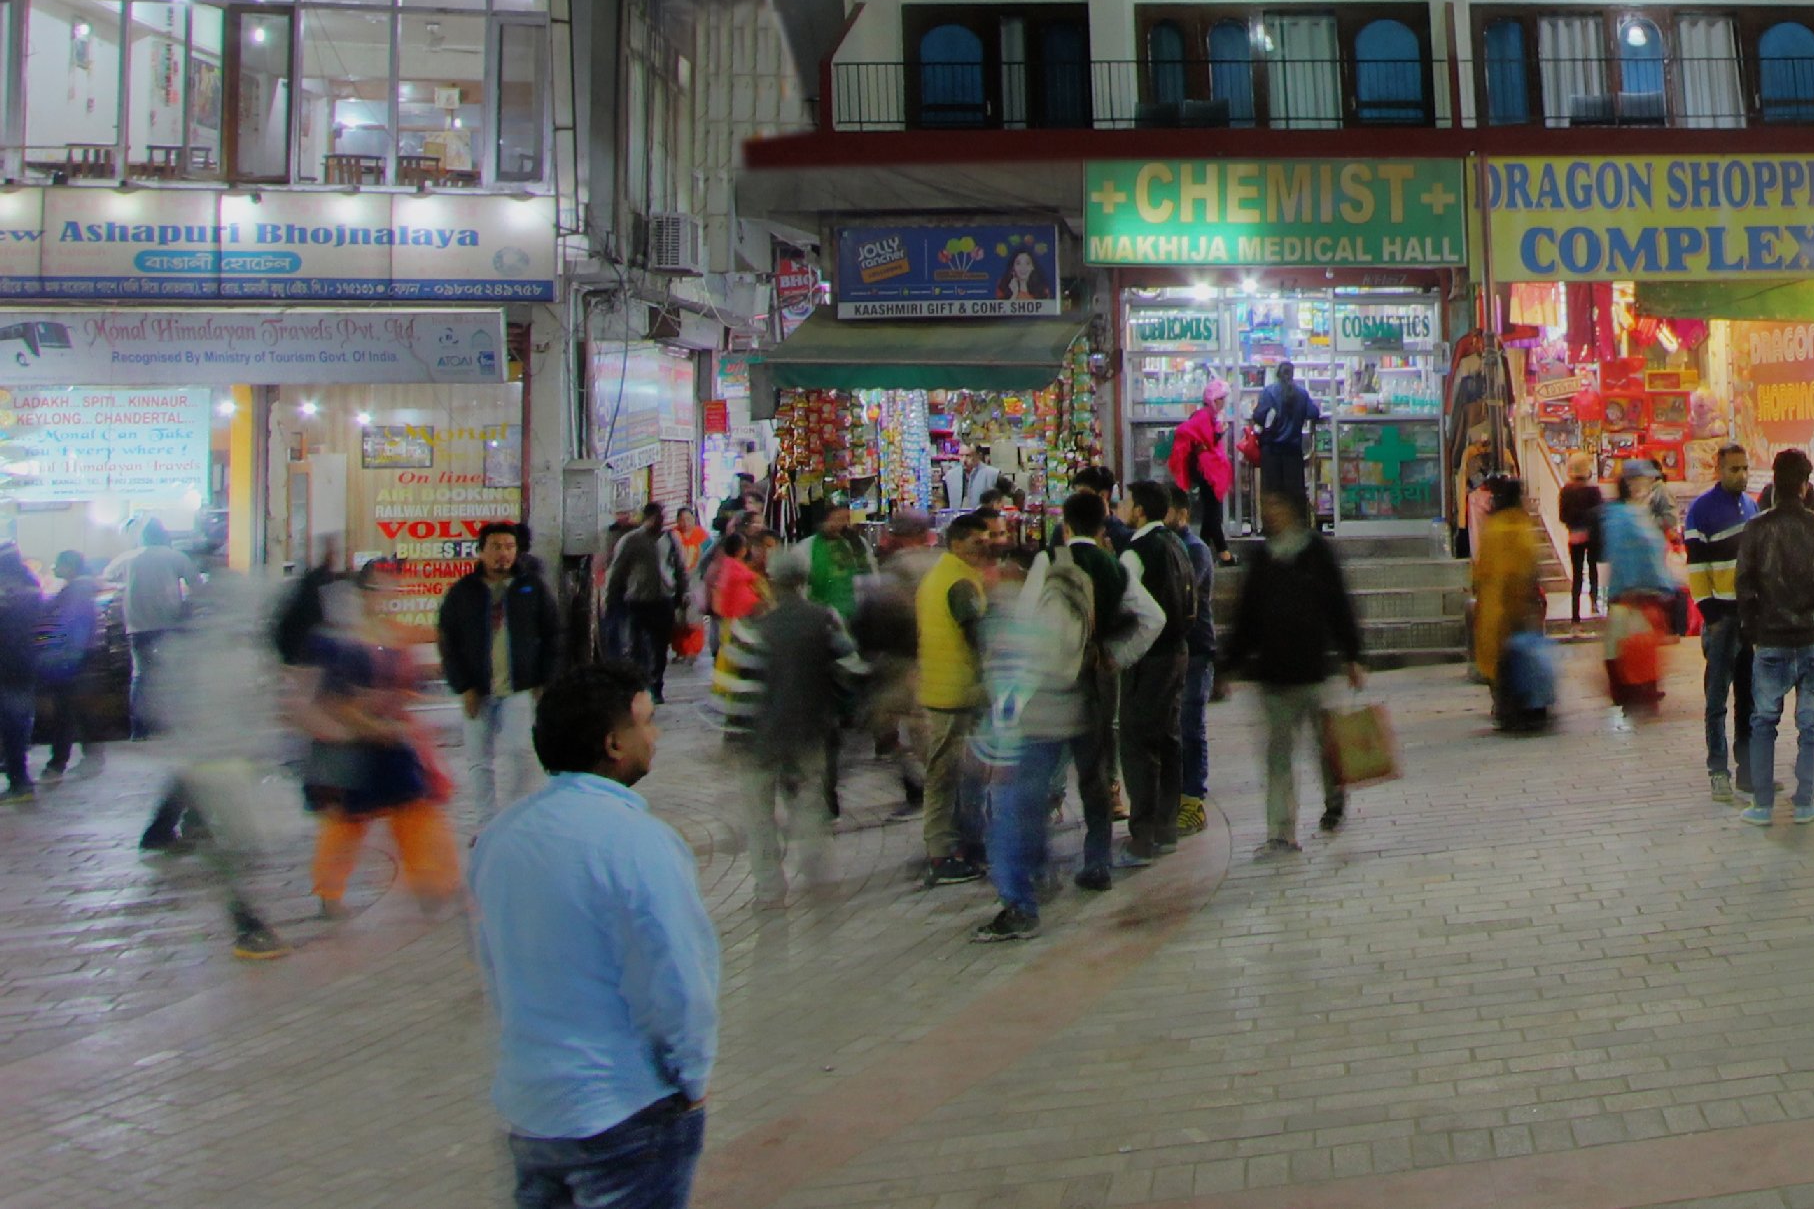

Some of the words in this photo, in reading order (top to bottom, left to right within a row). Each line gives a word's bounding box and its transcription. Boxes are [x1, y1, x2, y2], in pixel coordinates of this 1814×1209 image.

[1135, 163, 1415, 224] CHEMIST
[1473, 160, 1654, 211] DRAGON
[59, 221, 240, 246] Ashapuri
[257, 223, 479, 249] Bhojnalaya
[858, 237, 900, 261] JOLLY
[861, 249, 905, 269] rancher
[1090, 236, 1228, 263] MAKHIJA
[1238, 236, 1373, 263] MEDICAL
[1382, 237, 1459, 263] HALL
[854, 303, 923, 316] KAASHMIRI
[927, 302, 954, 315] GIFT
[958, 302, 967, 314] &
[972, 302, 1006, 314] CONF.
[1010, 301, 1042, 314] SHOP
[84, 318, 147, 353] Monal
[152, 318, 256, 350] Himalayan
[261, 318, 332, 346] Travels
[336, 318, 381, 349] Pvt.
[384, 317, 421, 349] Ltd.
[1342, 315, 1430, 338] COSMETICS
[112, 351, 182, 365] Recognised
[185, 352, 200, 365] By
[204, 351, 251, 365] Ministry
[254, 351, 266, 363] of
[269, 351, 315, 363] Tourism
[319, 352, 349, 363] Govt.
[353, 351, 367, 363] Of
[399, 471, 430, 486] On
[420, 488, 519, 502] BOOKING
[376, 504, 430, 518] RAILWAY
[434, 503, 519, 518] RESERVATION
[377, 520, 518, 540] VOLV
[397, 542, 455, 559] BUSES
